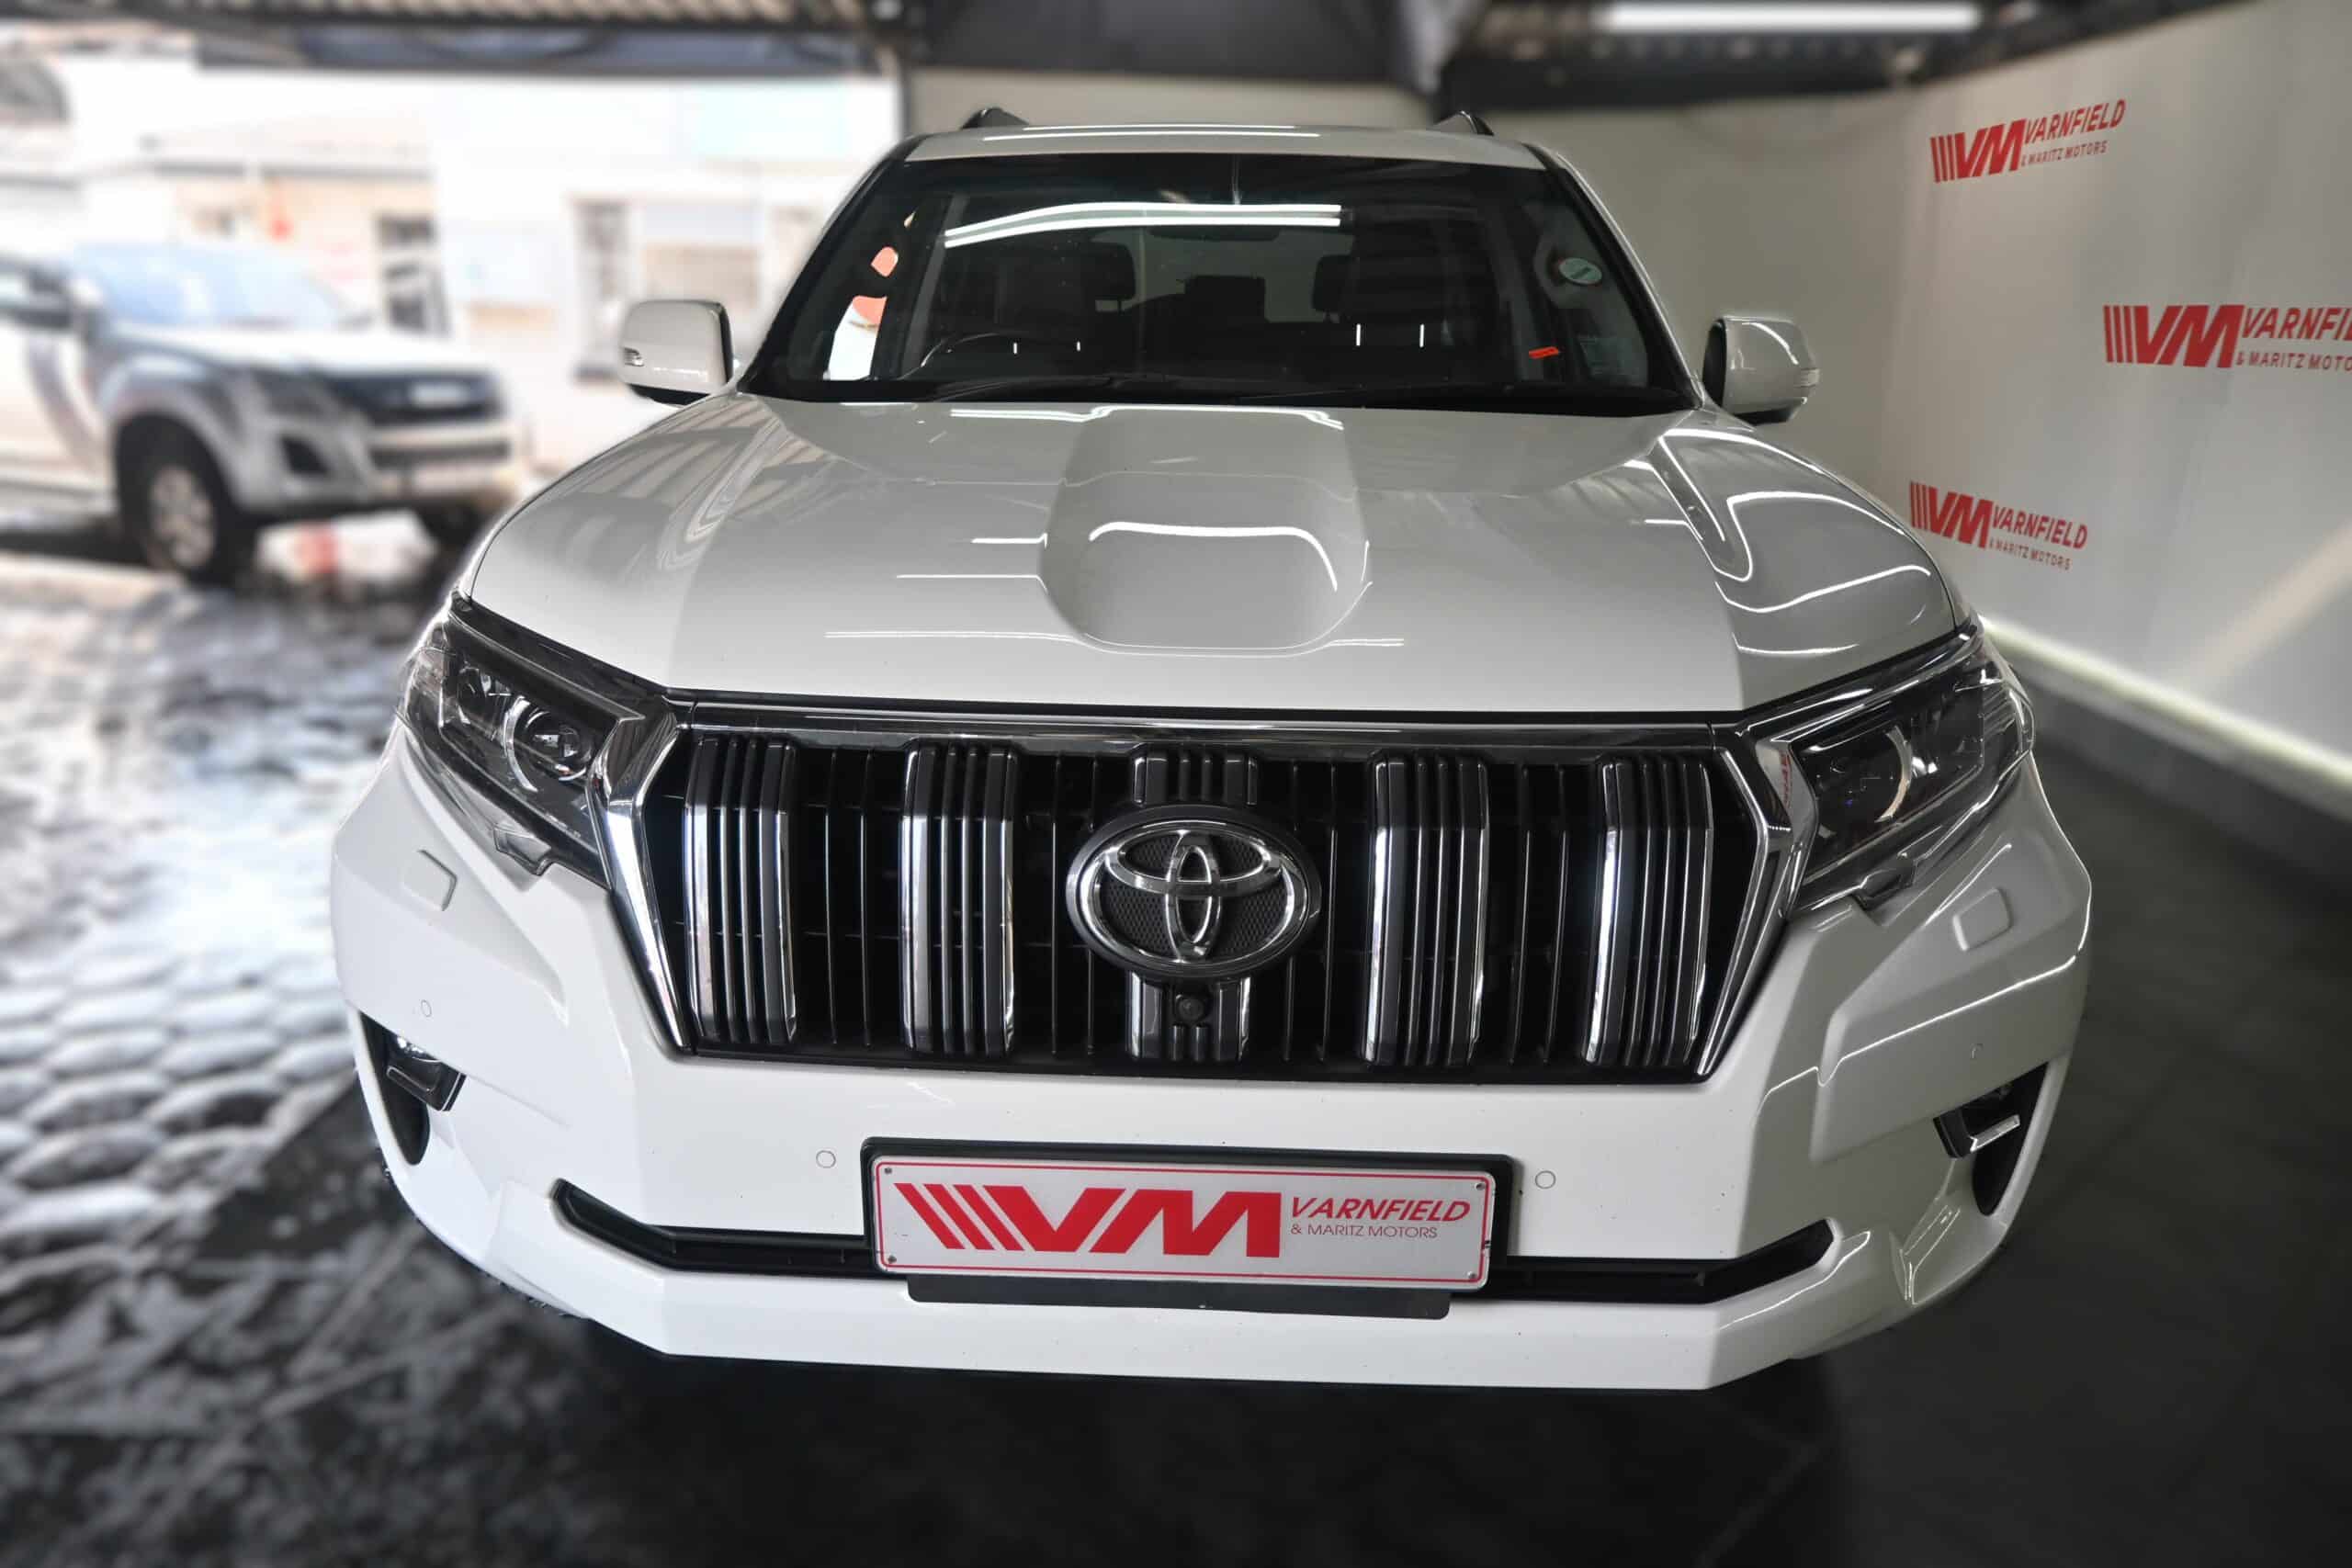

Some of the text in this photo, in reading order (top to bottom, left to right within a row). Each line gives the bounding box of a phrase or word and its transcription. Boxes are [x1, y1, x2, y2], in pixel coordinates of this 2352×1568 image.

[2024, 99, 2126, 144] VARNFIELD
[1954, 118, 2027, 179] VM
[2028, 147, 2064, 164] MARITZ
[2064, 140, 2108, 159] MOTORS
[2133, 304, 2245, 367] VM
[2236, 351, 2245, 366] &
[2249, 351, 2305, 368] MARITZ
[1928, 486, 2088, 549] VM VARNFIELD
[1996, 540, 2029, 558] MARITZ
[2030, 549, 2071, 570] MOTORS
[984, 1184, 1471, 1258] VM VARNFIELD
[1290, 1224, 1438, 1238] & MARITZ MOTORS
